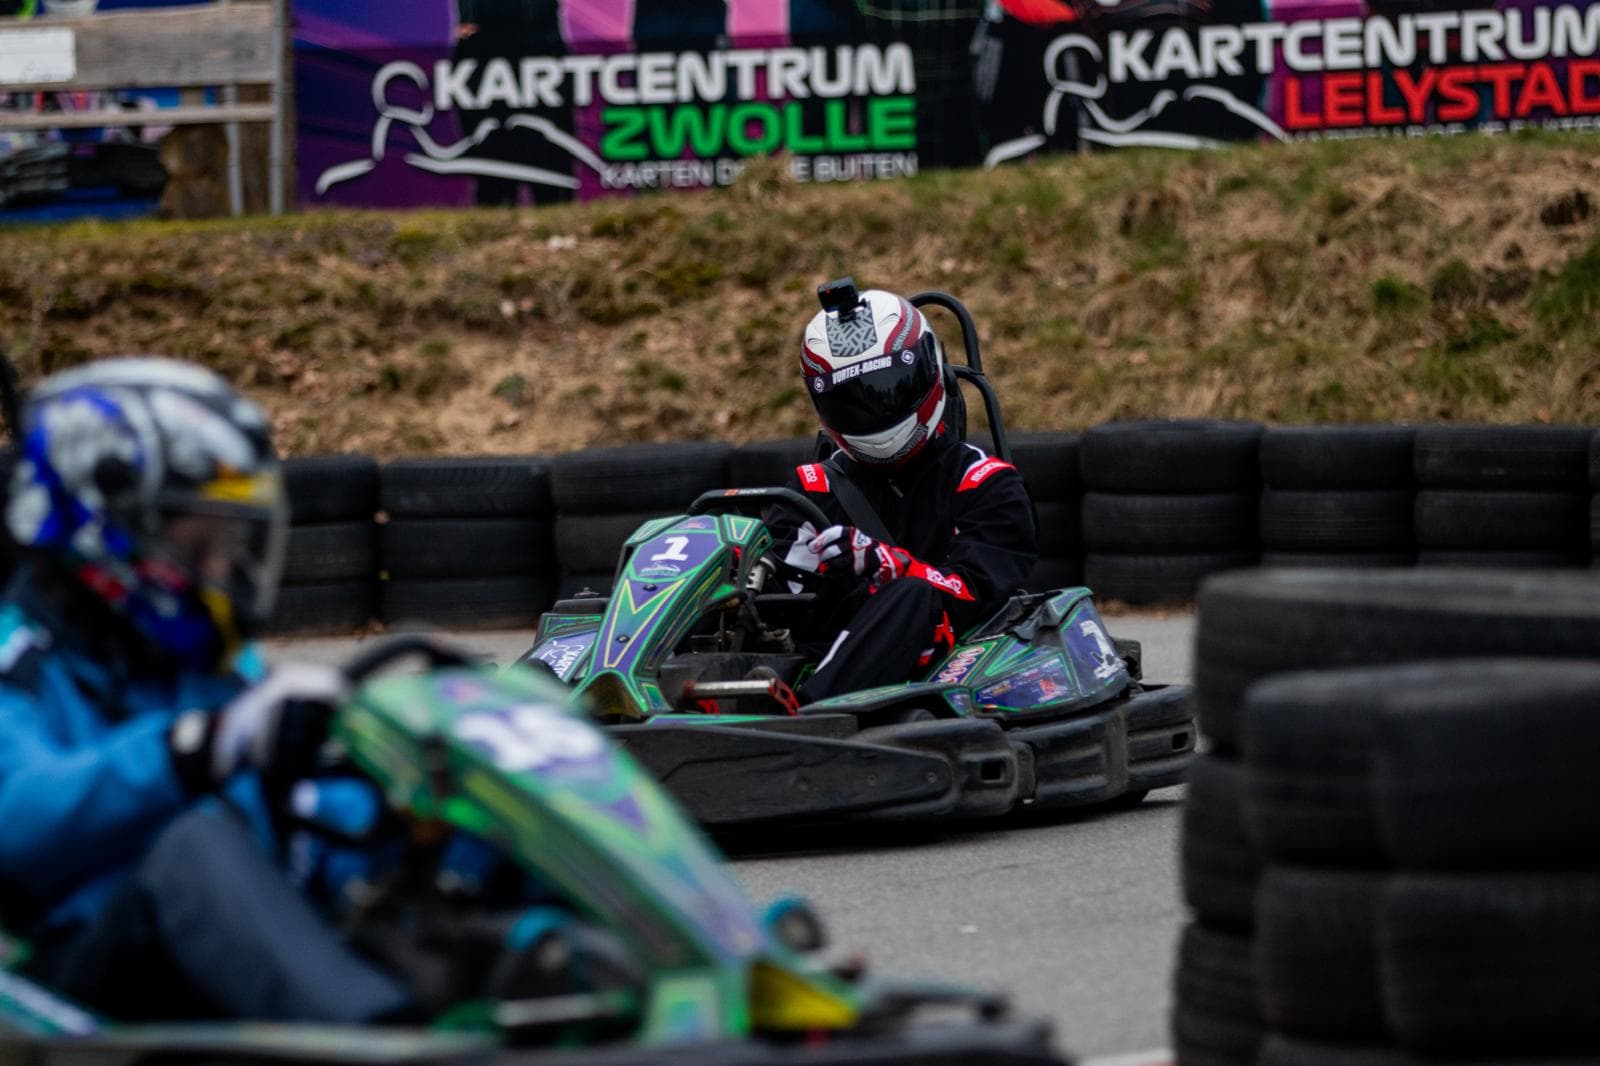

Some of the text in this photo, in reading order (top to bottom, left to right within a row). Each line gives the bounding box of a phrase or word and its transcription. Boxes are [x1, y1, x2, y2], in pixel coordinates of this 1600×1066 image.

[1108, 3, 1600, 83] KARTCENTRUM
[433, 42, 916, 111] KARTCENTRUM
[1283, 61, 1600, 129] LELYSTAD
[602, 96, 917, 161] ZWOLLE
[601, 158, 715, 189] KARTEN
[813, 152, 919, 183] BUITEN
[650, 535, 689, 561] 1
[1080, 619, 1120, 679] 1
